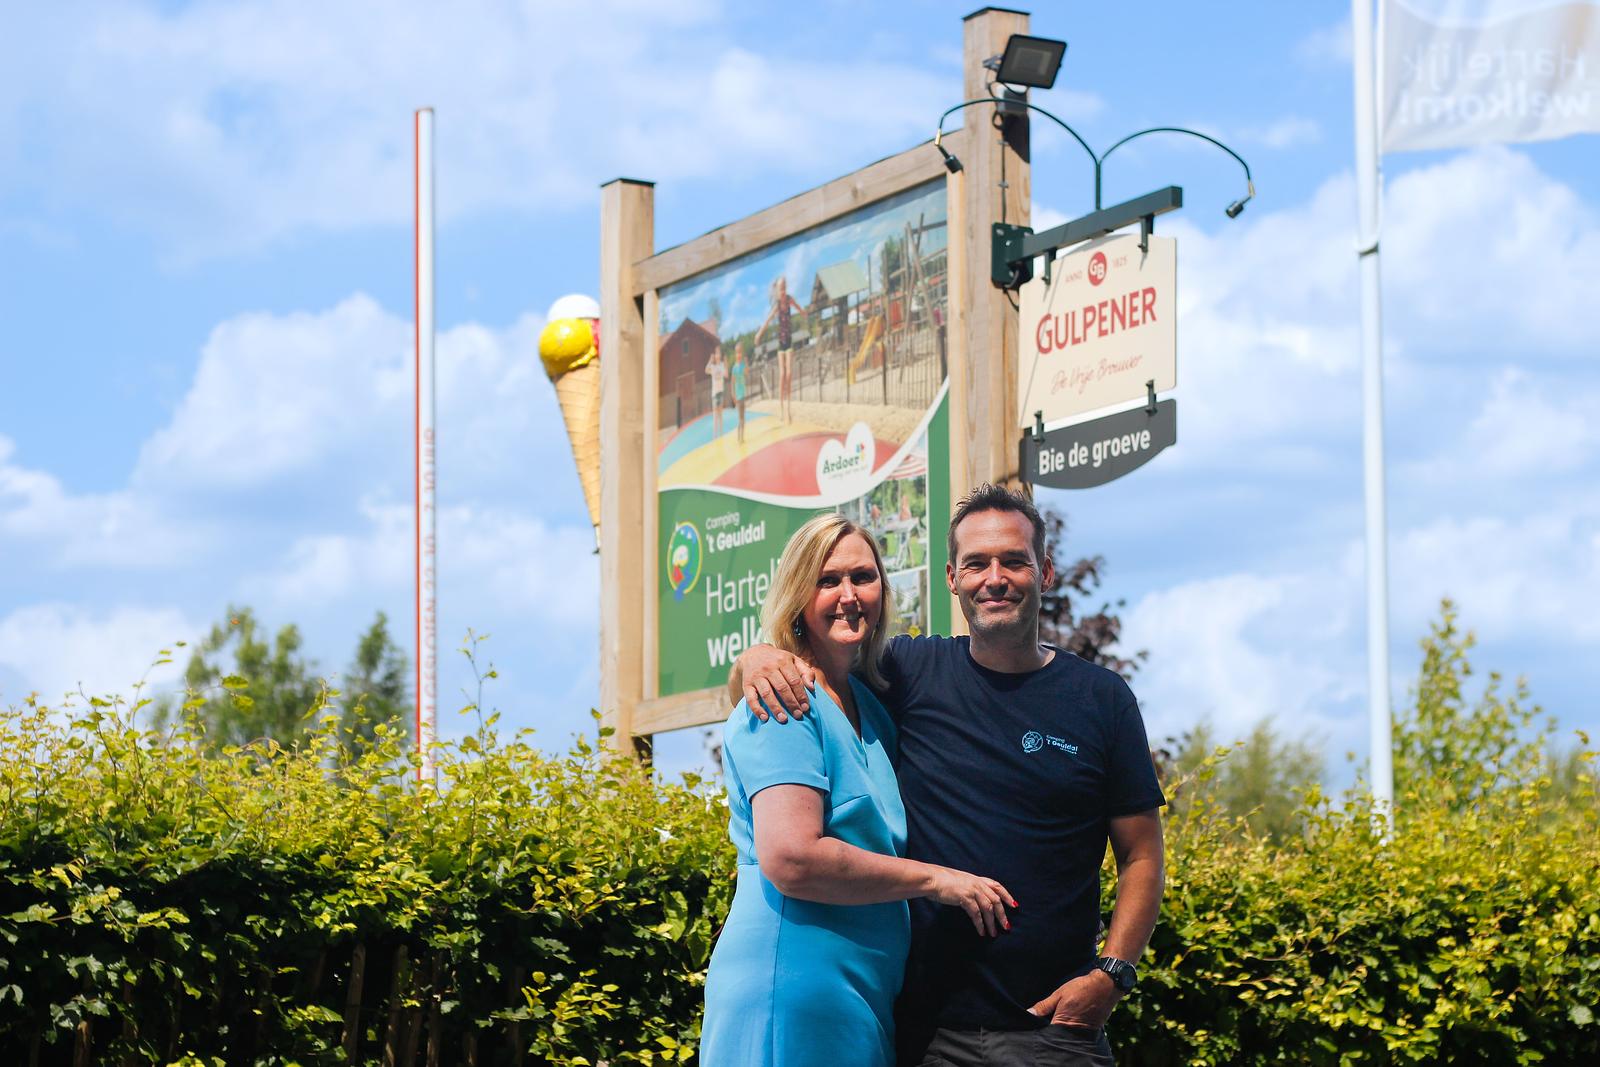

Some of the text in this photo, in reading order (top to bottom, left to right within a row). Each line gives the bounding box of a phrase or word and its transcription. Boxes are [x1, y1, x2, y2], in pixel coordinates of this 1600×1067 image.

[1035, 286, 1157, 354] GULPENER
[822, 455, 860, 475] Ardoer
[1038, 429, 1151, 476] Bie de groeve
[705, 511, 741, 530] Camping
[705, 520, 766, 554] 't Geuldal
[706, 558, 779, 617] Hartel
[706, 616, 762, 668] welk
[1051, 740, 1079, 752] Geuldal
